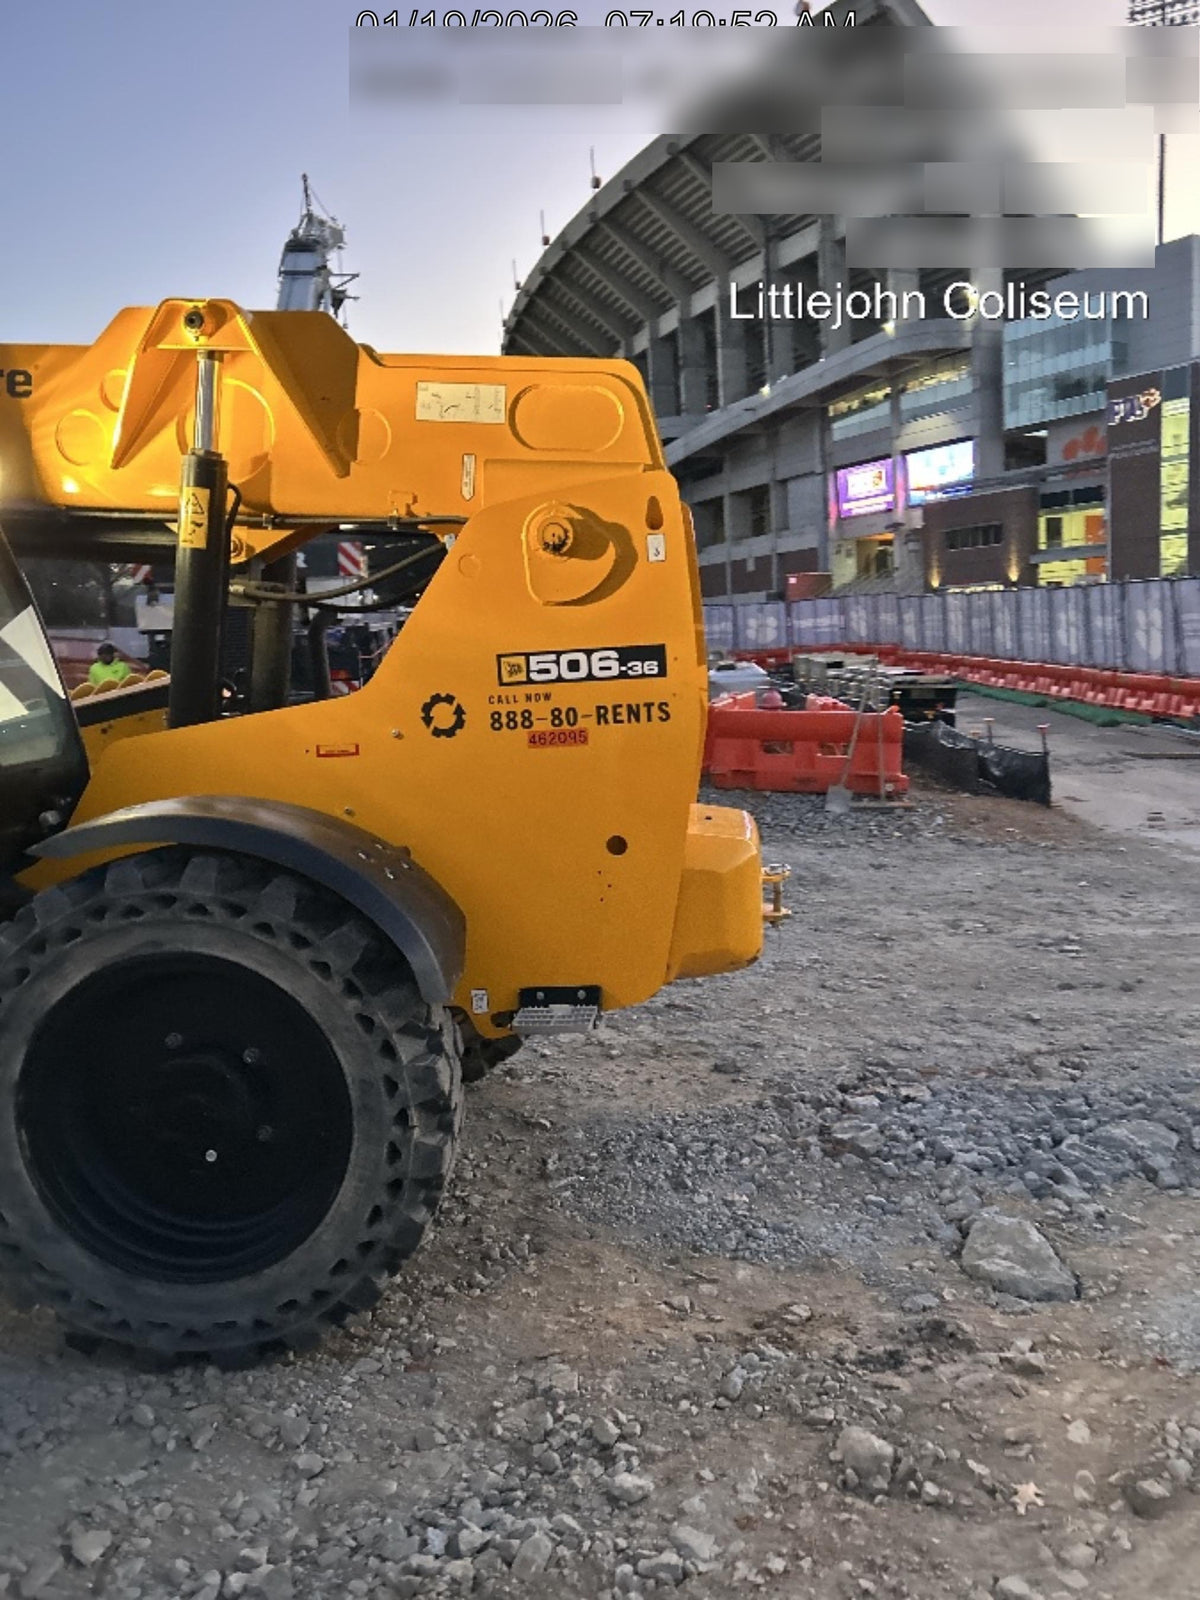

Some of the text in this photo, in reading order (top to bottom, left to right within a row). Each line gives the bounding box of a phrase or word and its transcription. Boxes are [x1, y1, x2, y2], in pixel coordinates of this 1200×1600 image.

[0, 369, 32, 398] e
[528, 650, 660, 682] 506-36
[488, 692, 552, 705] CALL NOW
[489, 701, 672, 731] 888-80-RENTS
[528, 730, 588, 746] 462095
